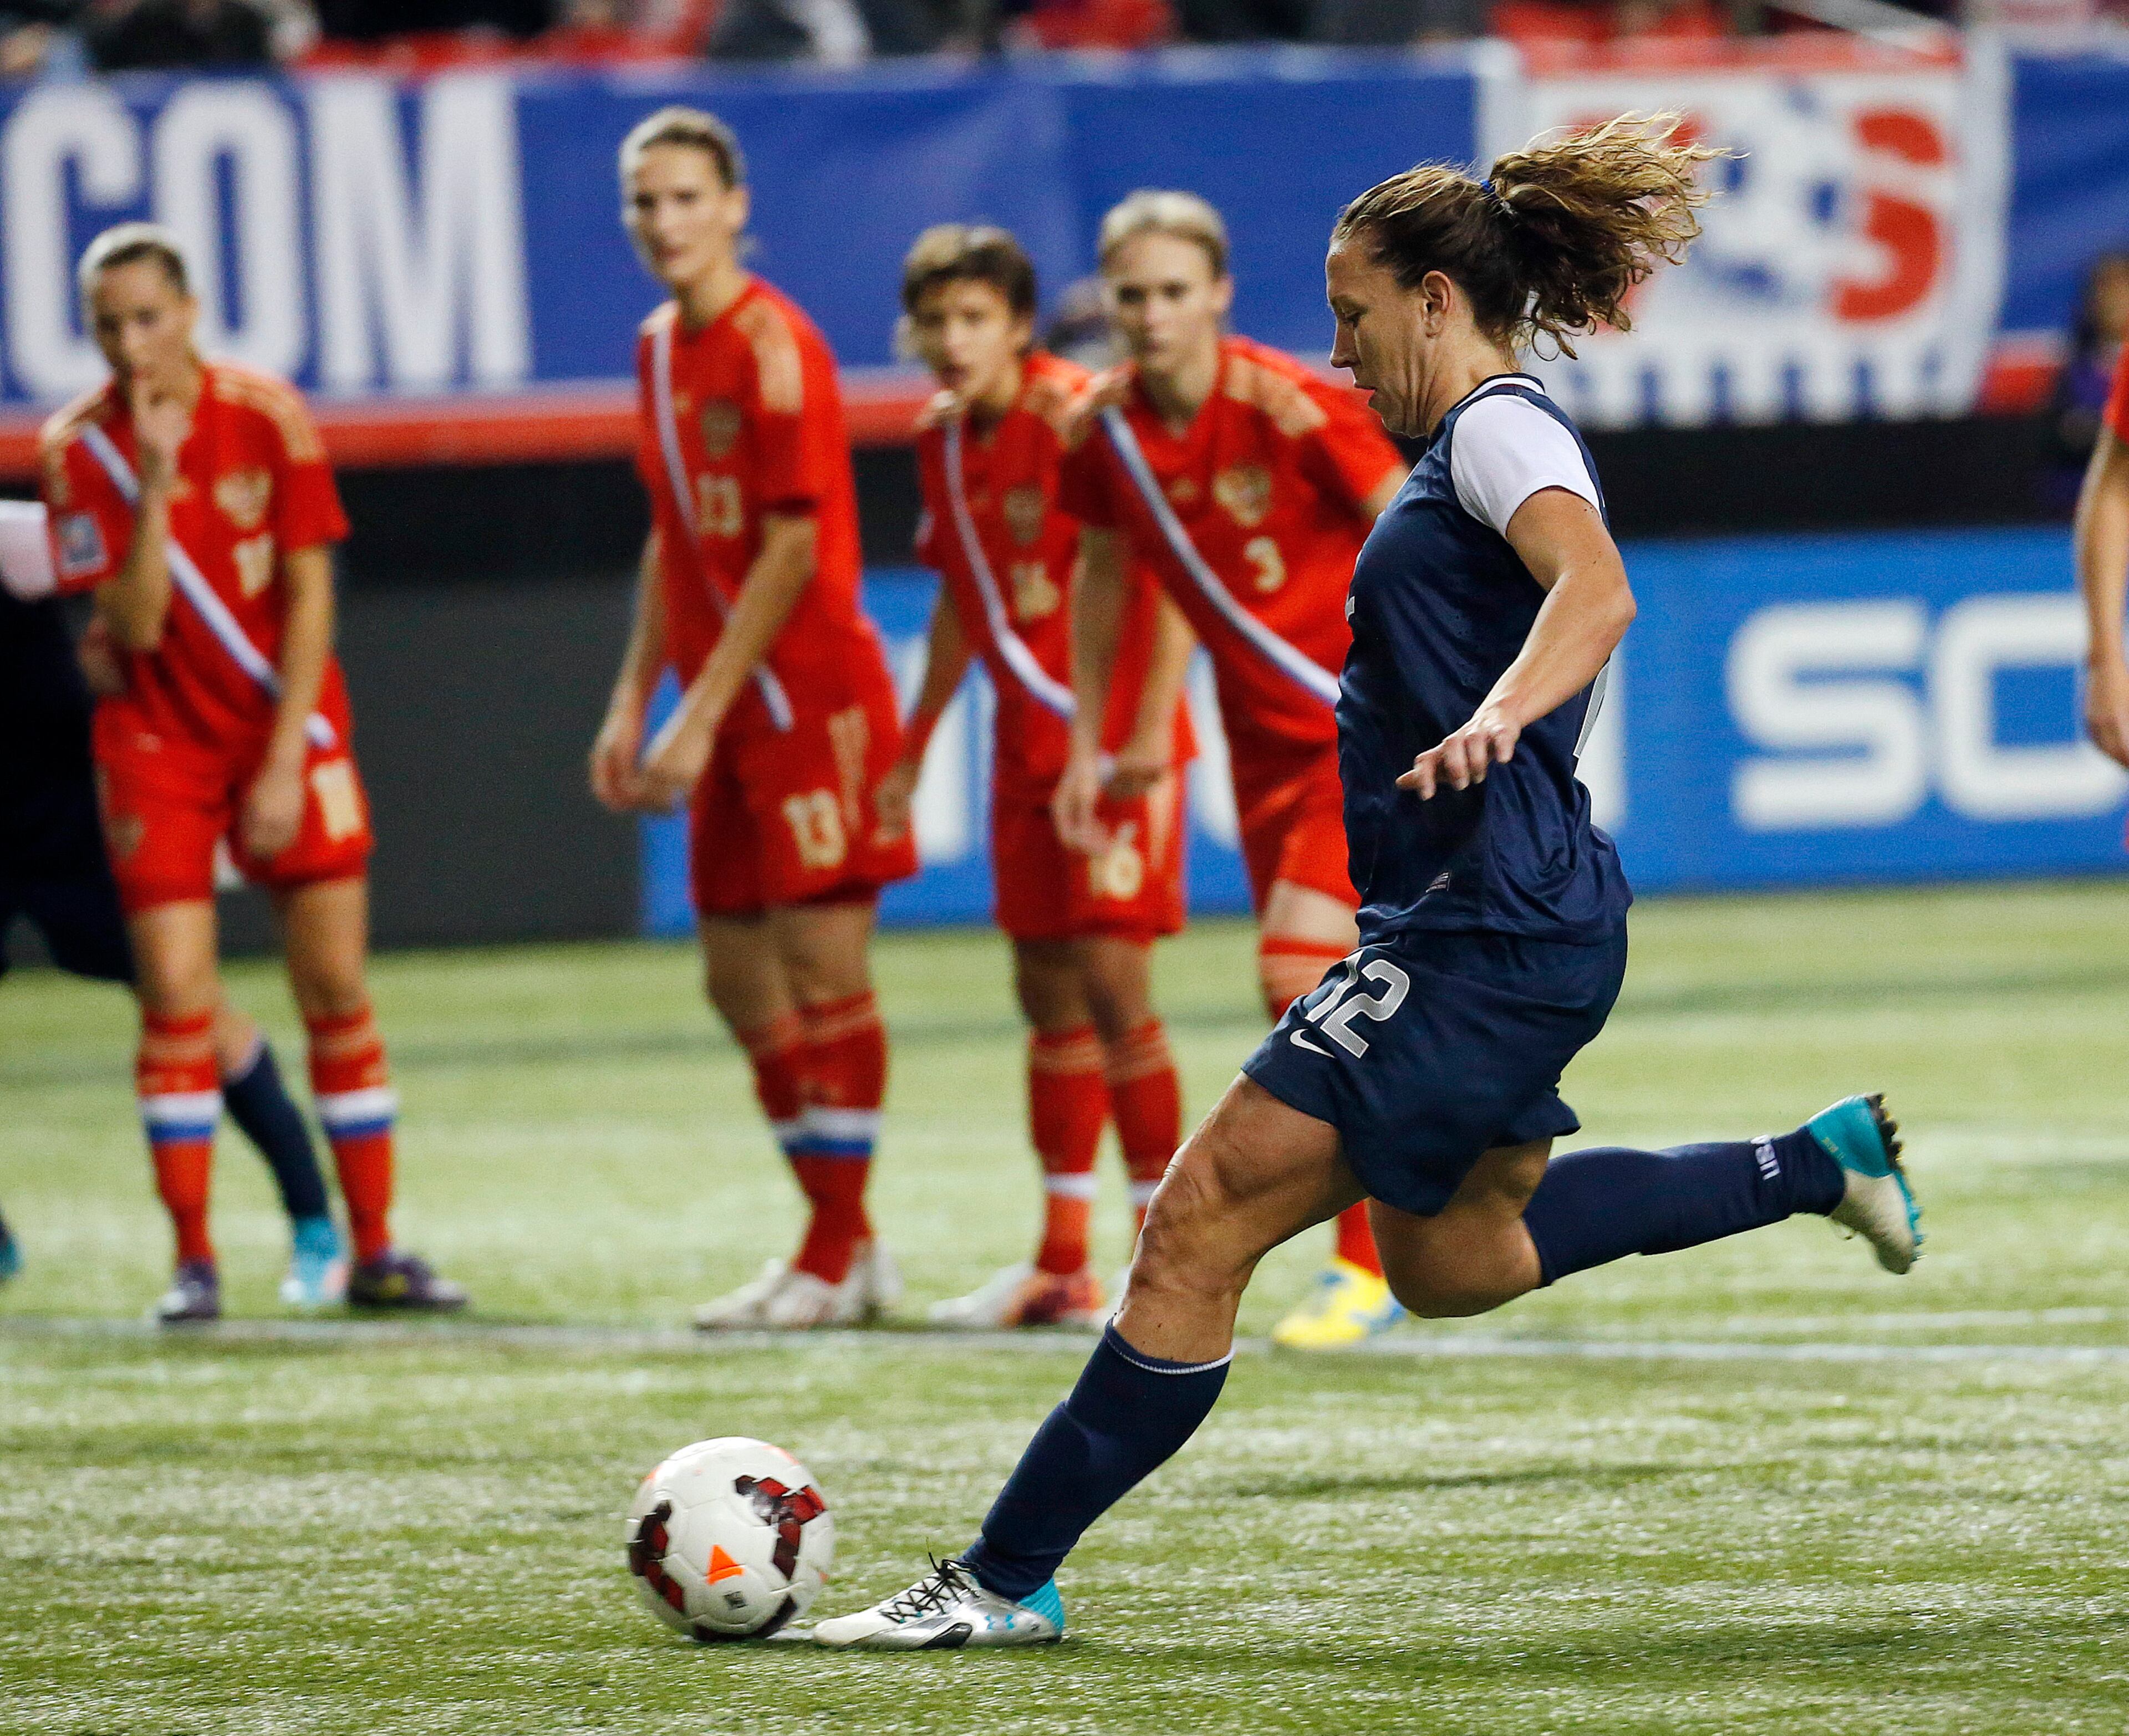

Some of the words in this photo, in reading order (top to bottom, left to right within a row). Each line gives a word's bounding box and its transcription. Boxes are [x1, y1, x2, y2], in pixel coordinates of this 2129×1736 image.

[4, 76, 530, 395] COM
[1244, 535, 1286, 593] 3
[782, 789, 847, 868] 13
[1304, 949, 1410, 1058] 12
